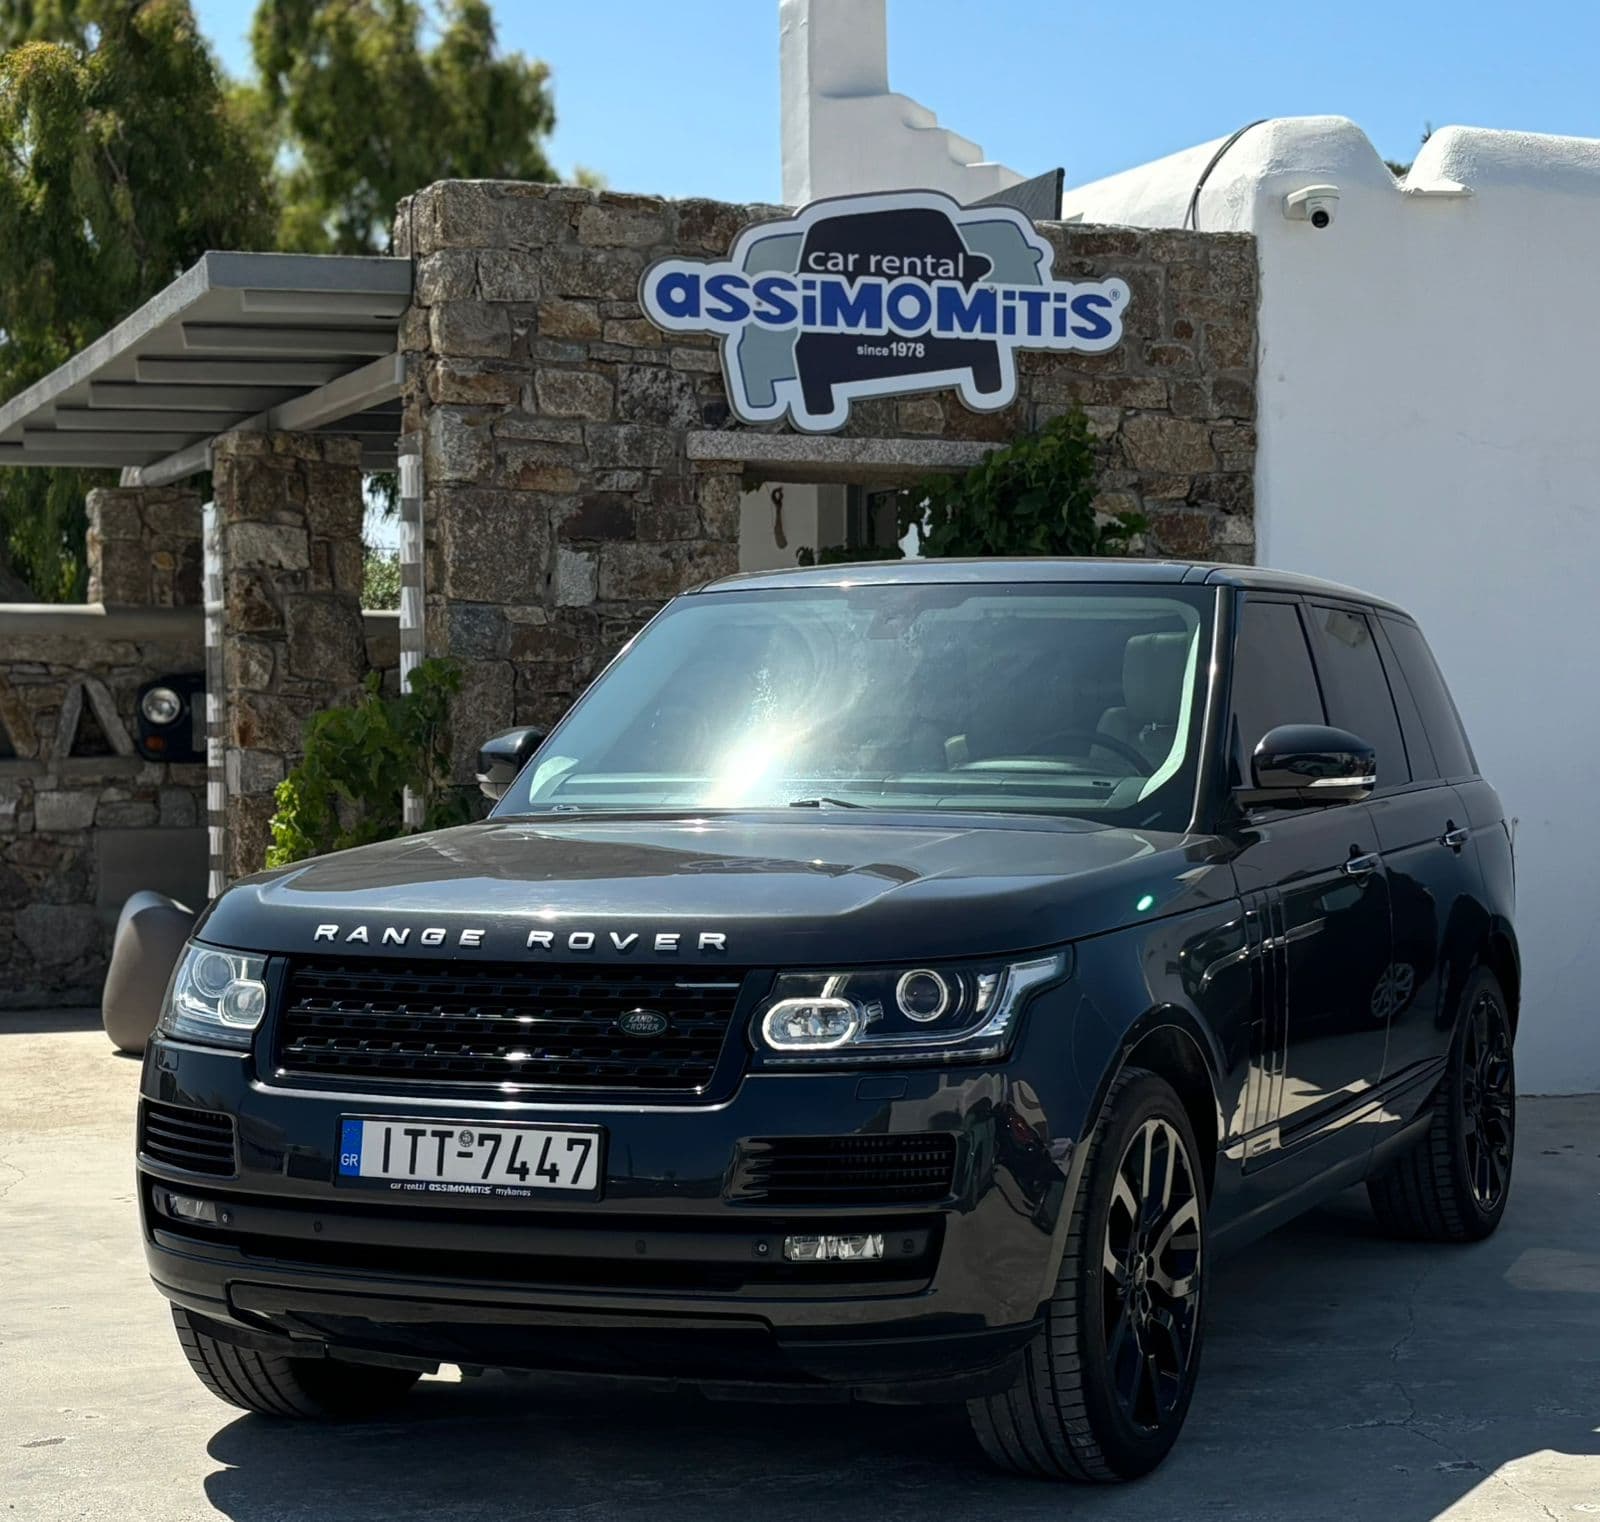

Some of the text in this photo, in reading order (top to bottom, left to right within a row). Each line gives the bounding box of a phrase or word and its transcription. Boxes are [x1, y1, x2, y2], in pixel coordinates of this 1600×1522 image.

[807, 250, 965, 279] car rental
[891, 342, 926, 358] 1978
[313, 924, 728, 951] RANGE ROVER
[629, 1015, 654, 1023] LAND
[630, 1023, 659, 1032] ROVER
[340, 1153, 359, 1167] GR
